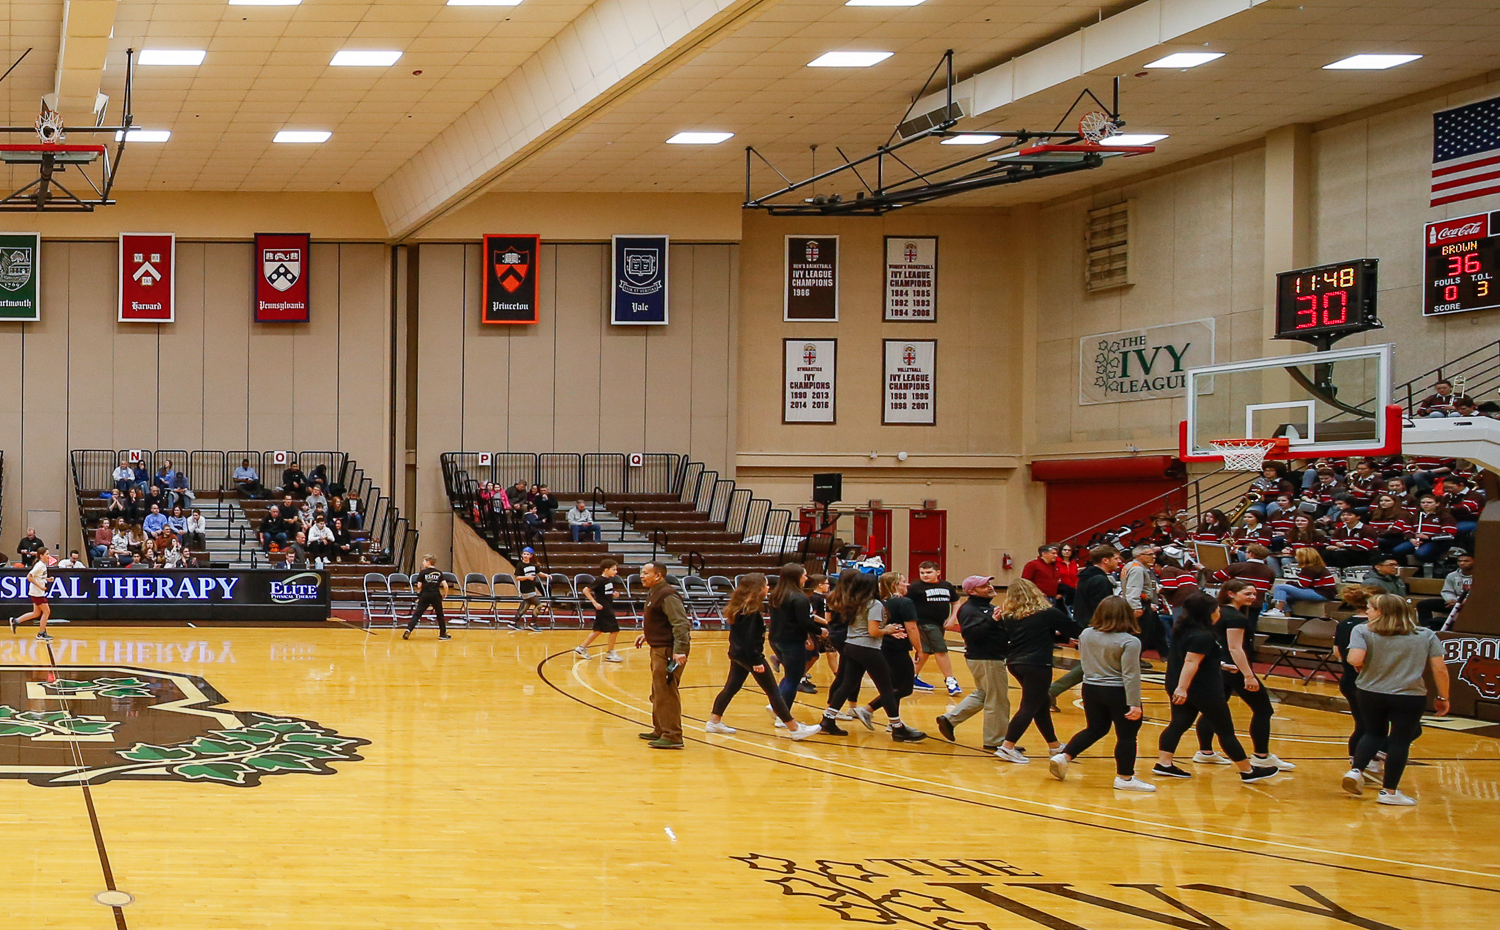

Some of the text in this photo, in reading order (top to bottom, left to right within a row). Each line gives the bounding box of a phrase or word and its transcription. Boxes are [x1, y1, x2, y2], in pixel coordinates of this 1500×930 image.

[1438, 221, 1483, 240] Coca-Cola
[1442, 241, 1478, 256] BROWN
[1448, 253, 1481, 276] 36
[792, 270, 832, 278] IVY LEAGUE
[1471, 273, 1493, 281] T.O.L.
[792, 279, 833, 287] CHAMPIONS
[890, 279, 931, 287] CHAMPIONS
[1296, 267, 1355, 294] 11:48
[1434, 277, 1461, 287] FOULS
[1444, 285, 1458, 301] 0
[1477, 280, 1489, 296] 3
[132, 301, 162, 311] Harvard
[259, 301, 305, 311] Pennsylvania
[492, 301, 529, 311] Princeton
[631, 302, 649, 312] Yale
[1295, 290, 1348, 329] 30
[1434, 302, 1461, 312] SCORE
[1119, 335, 1146, 347] THE
[1118, 342, 1191, 378] IVY
[131, 452, 140, 460] N
[276, 453, 285, 462] O
[481, 454, 489, 463] P
[631, 455, 641, 464] Q
[93, 577, 239, 599] THERAPY
[1441, 637, 1500, 664] BRO
[866, 858, 1043, 877] THE
